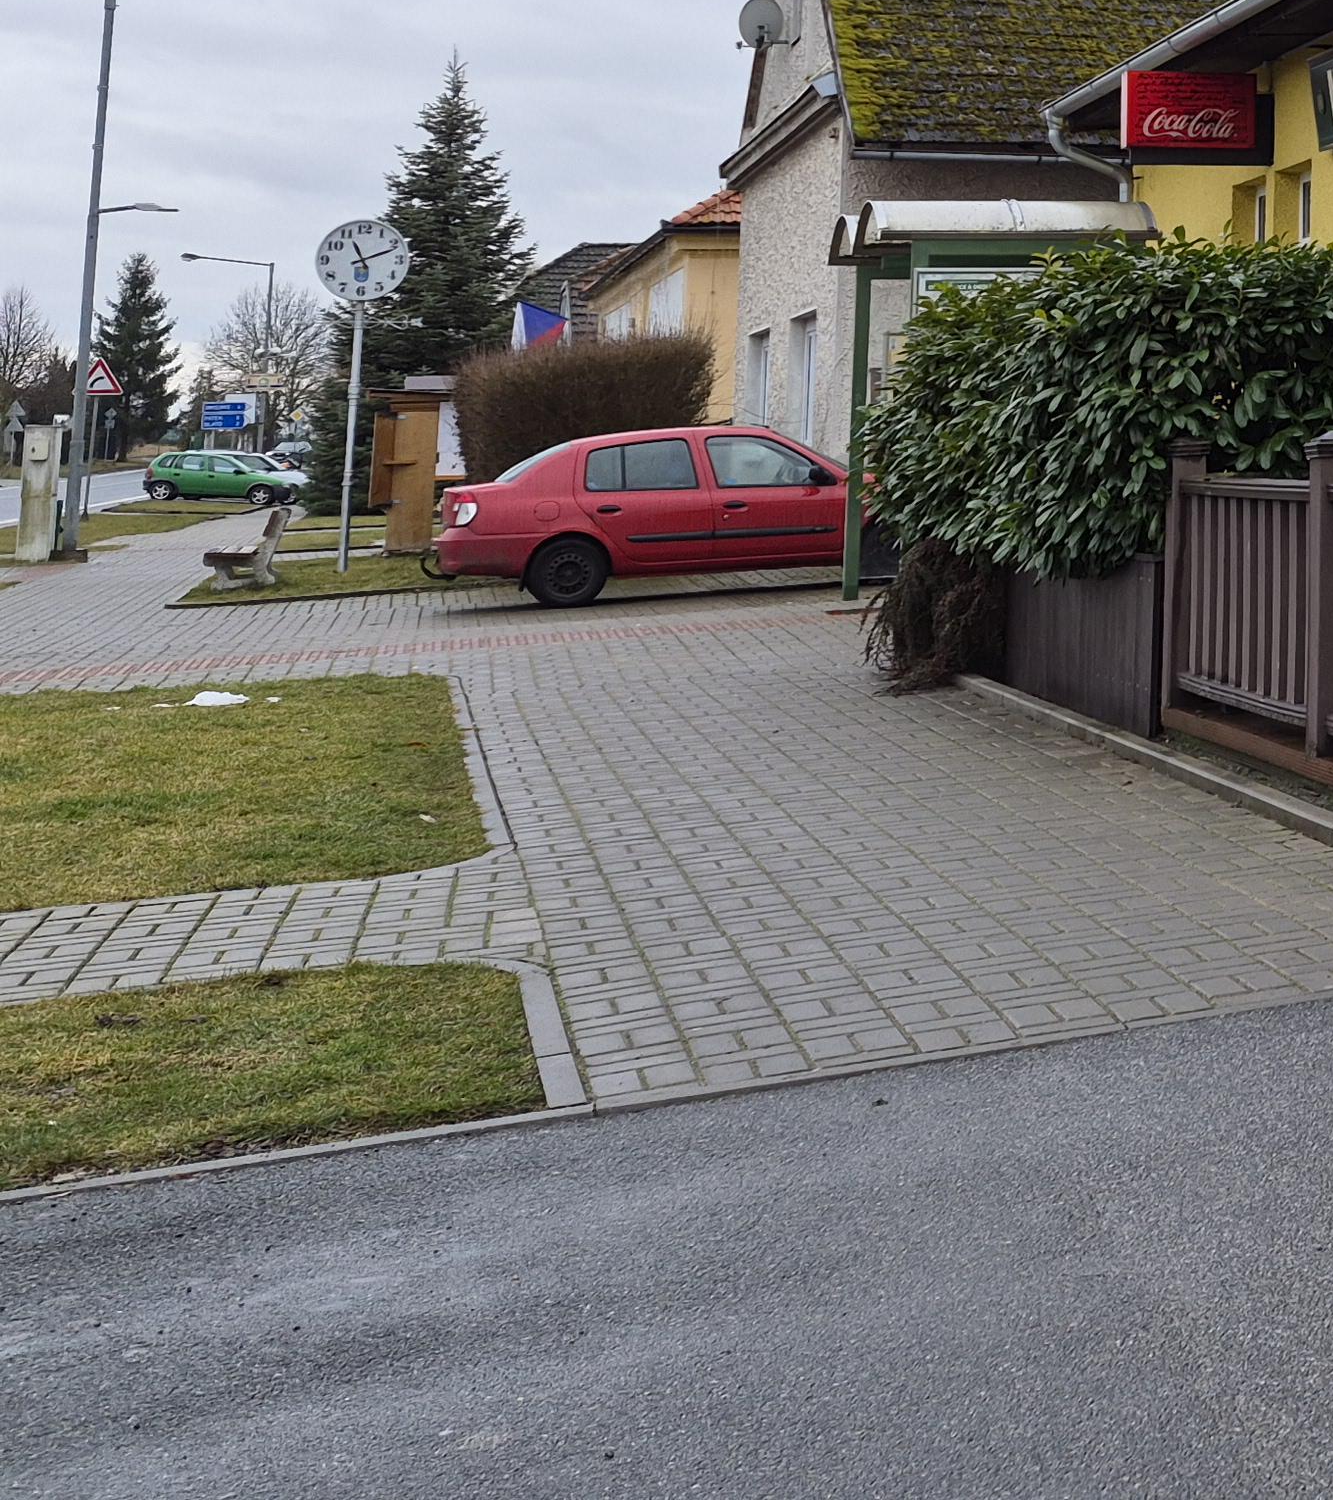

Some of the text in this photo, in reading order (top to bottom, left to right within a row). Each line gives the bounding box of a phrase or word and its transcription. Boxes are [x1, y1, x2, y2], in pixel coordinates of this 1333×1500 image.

[1142, 106, 1240, 139] Coca-Cola
[340, 228, 353, 239] 11
[357, 223, 373, 235] 12
[379, 227, 385, 239] 1
[326, 240, 344, 251] 10
[388, 238, 399, 249] 2
[320, 254, 330, 266] 9
[394, 254, 404, 265] 3
[325, 270, 336, 281] 8
[386, 269, 396, 280] 4
[338, 281, 348, 293] 7
[355, 285, 366, 297] 6
[373, 281, 384, 292] 5
